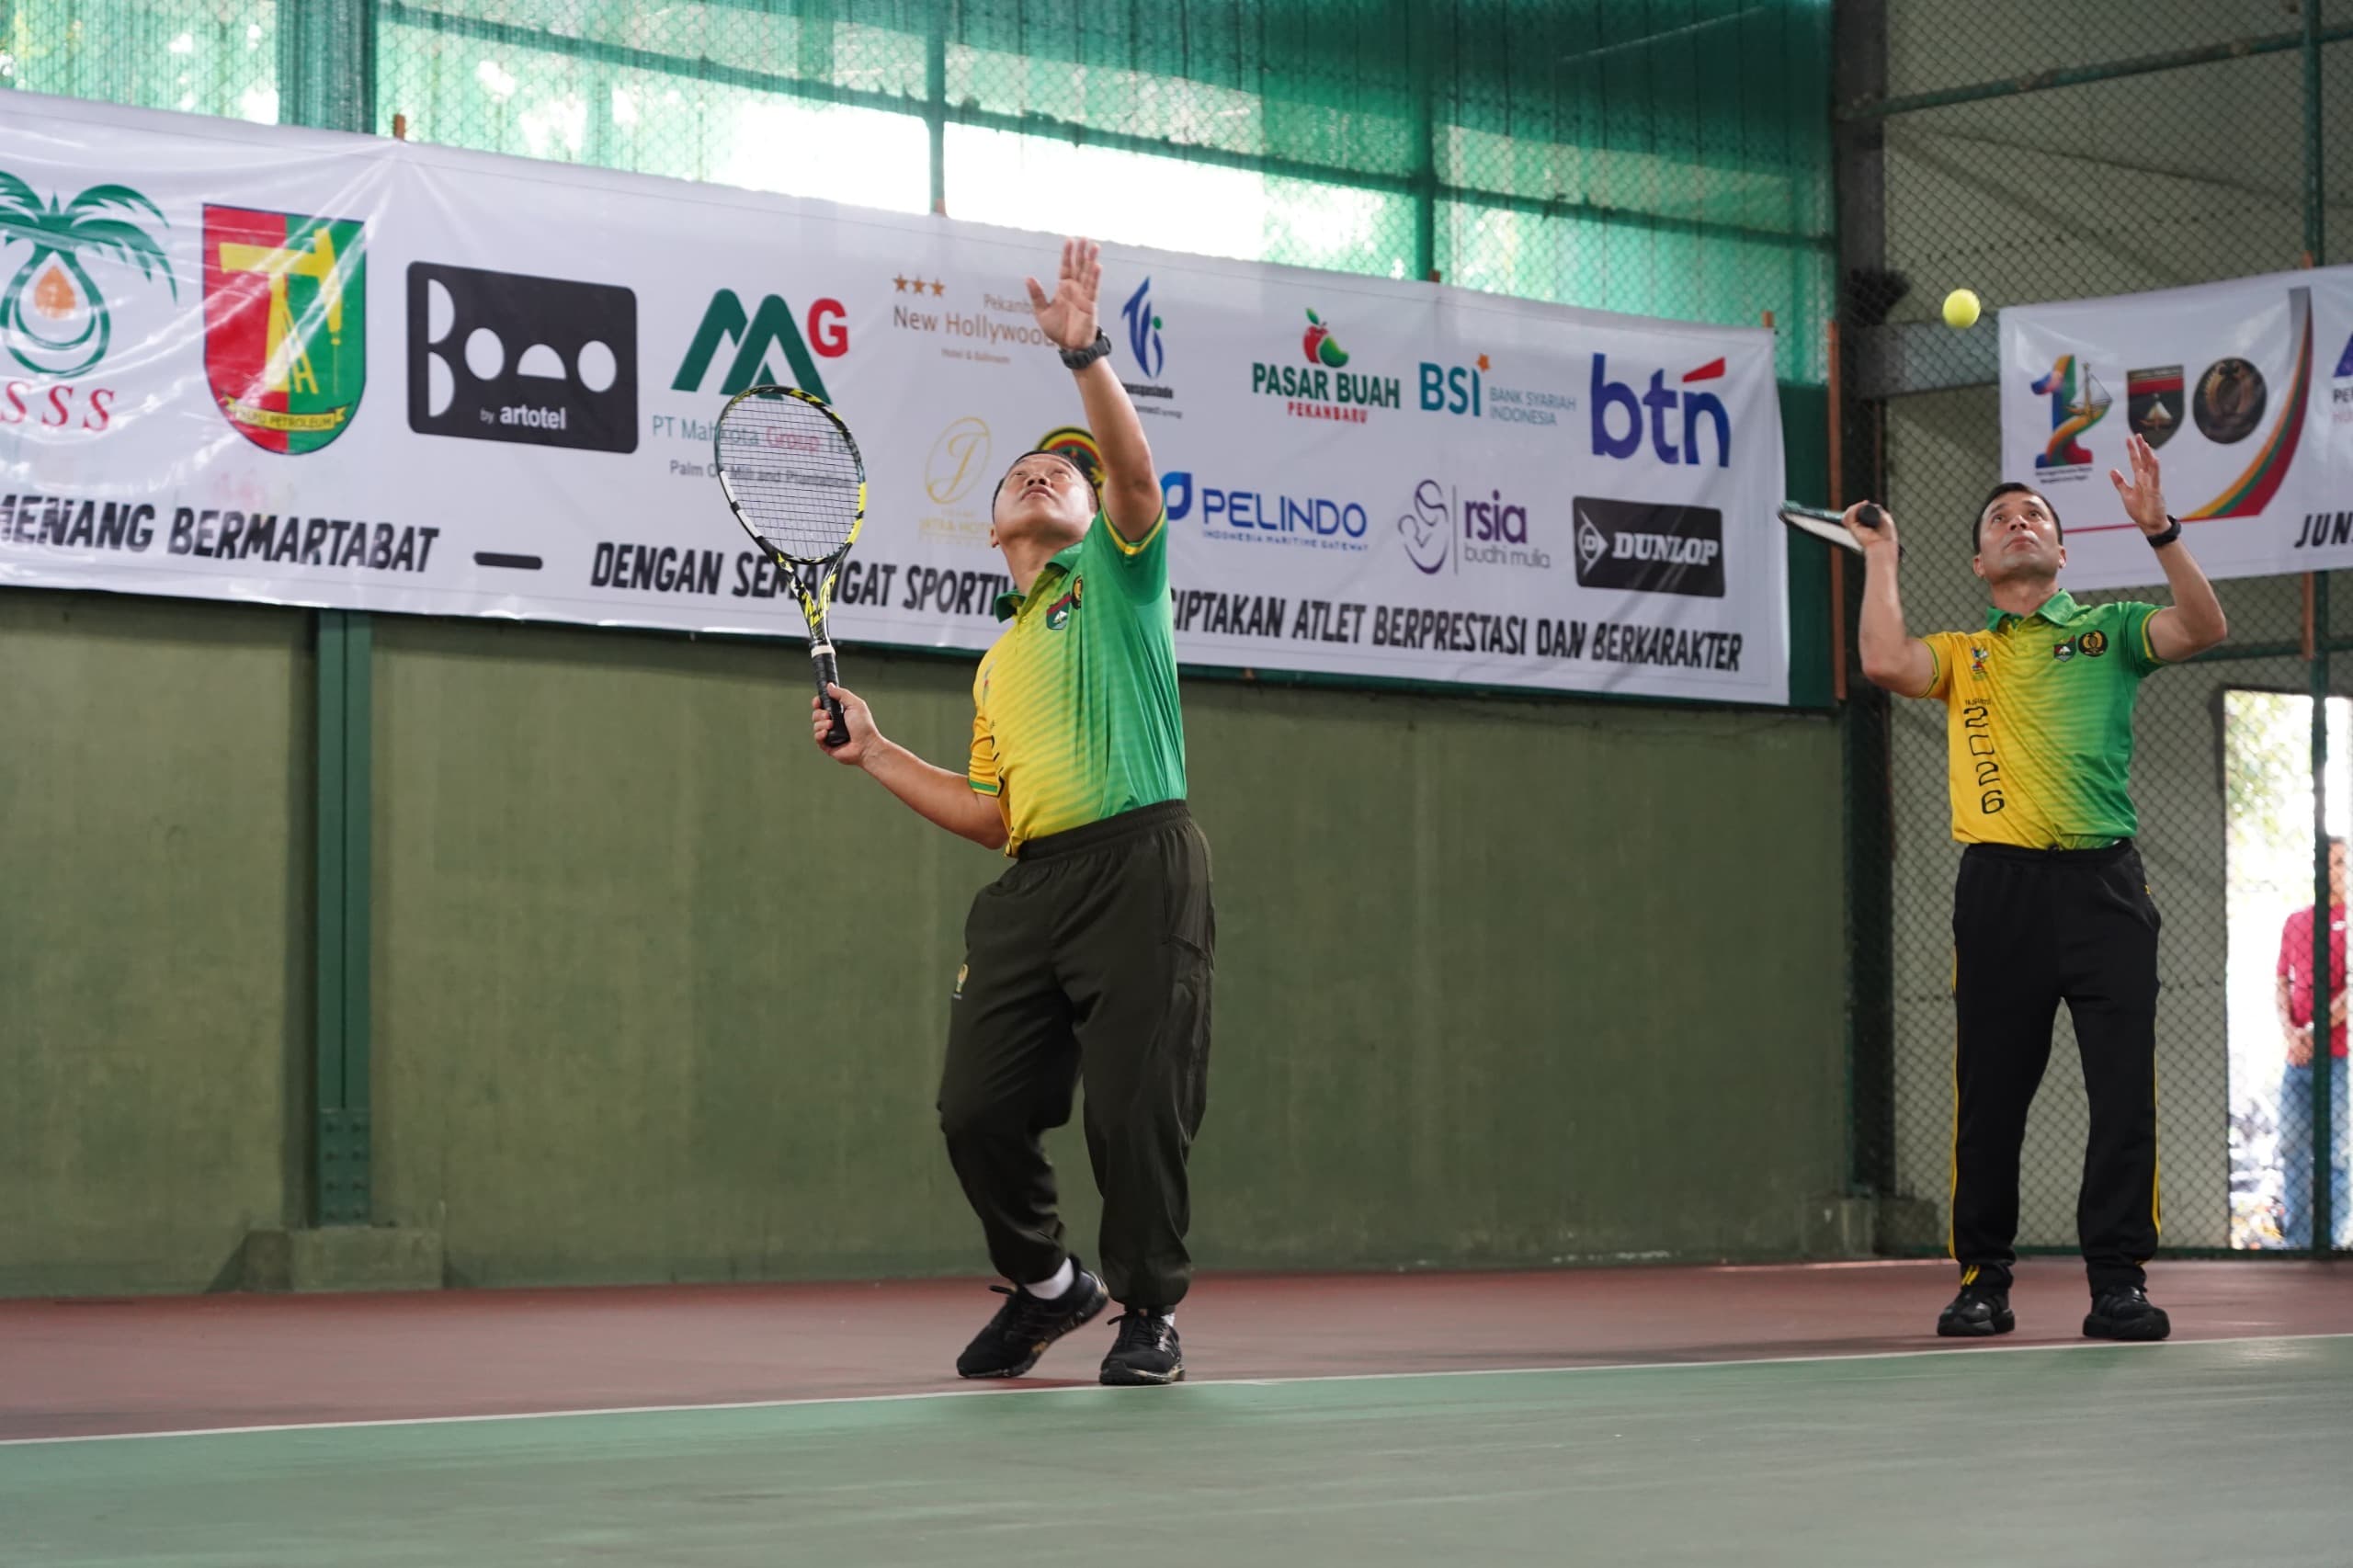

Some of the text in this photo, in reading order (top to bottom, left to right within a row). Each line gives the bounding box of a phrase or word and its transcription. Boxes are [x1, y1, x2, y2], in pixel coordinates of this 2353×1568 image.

[892, 304, 938, 332] New
[983, 294, 1033, 315] Pekanb
[1252, 362, 1400, 409] PASAR BUAH
[1419, 362, 1481, 417] BSI
[1489, 387, 1576, 411] BANK SYARIAH
[480, 404, 566, 429] by artotel
[1288, 402, 1368, 424] PEKANBARU
[1490, 406, 1558, 426] INDONESIA
[1591, 353, 1731, 467] btn
[653, 415, 675, 437] PT
[681, 416, 759, 447] Mahota
[670, 460, 703, 478] Palm
[1202, 488, 1367, 538] PELINDO
[1464, 490, 1528, 544] rsia
[1202, 529, 1262, 542] INDONESIA
[2294, 511, 2353, 548] JUN
[1464, 543, 1507, 562] budhi
[1612, 532, 1719, 565] DUNLOP
[167, 506, 439, 573] BERMARTABAT
[590, 541, 723, 595] DENGAN
[1291, 599, 1367, 643] ATLET
[1372, 605, 1528, 656] BERPRESTASI
[1537, 619, 1586, 660] DAN
[1591, 622, 1743, 672] BERKARAKTER
